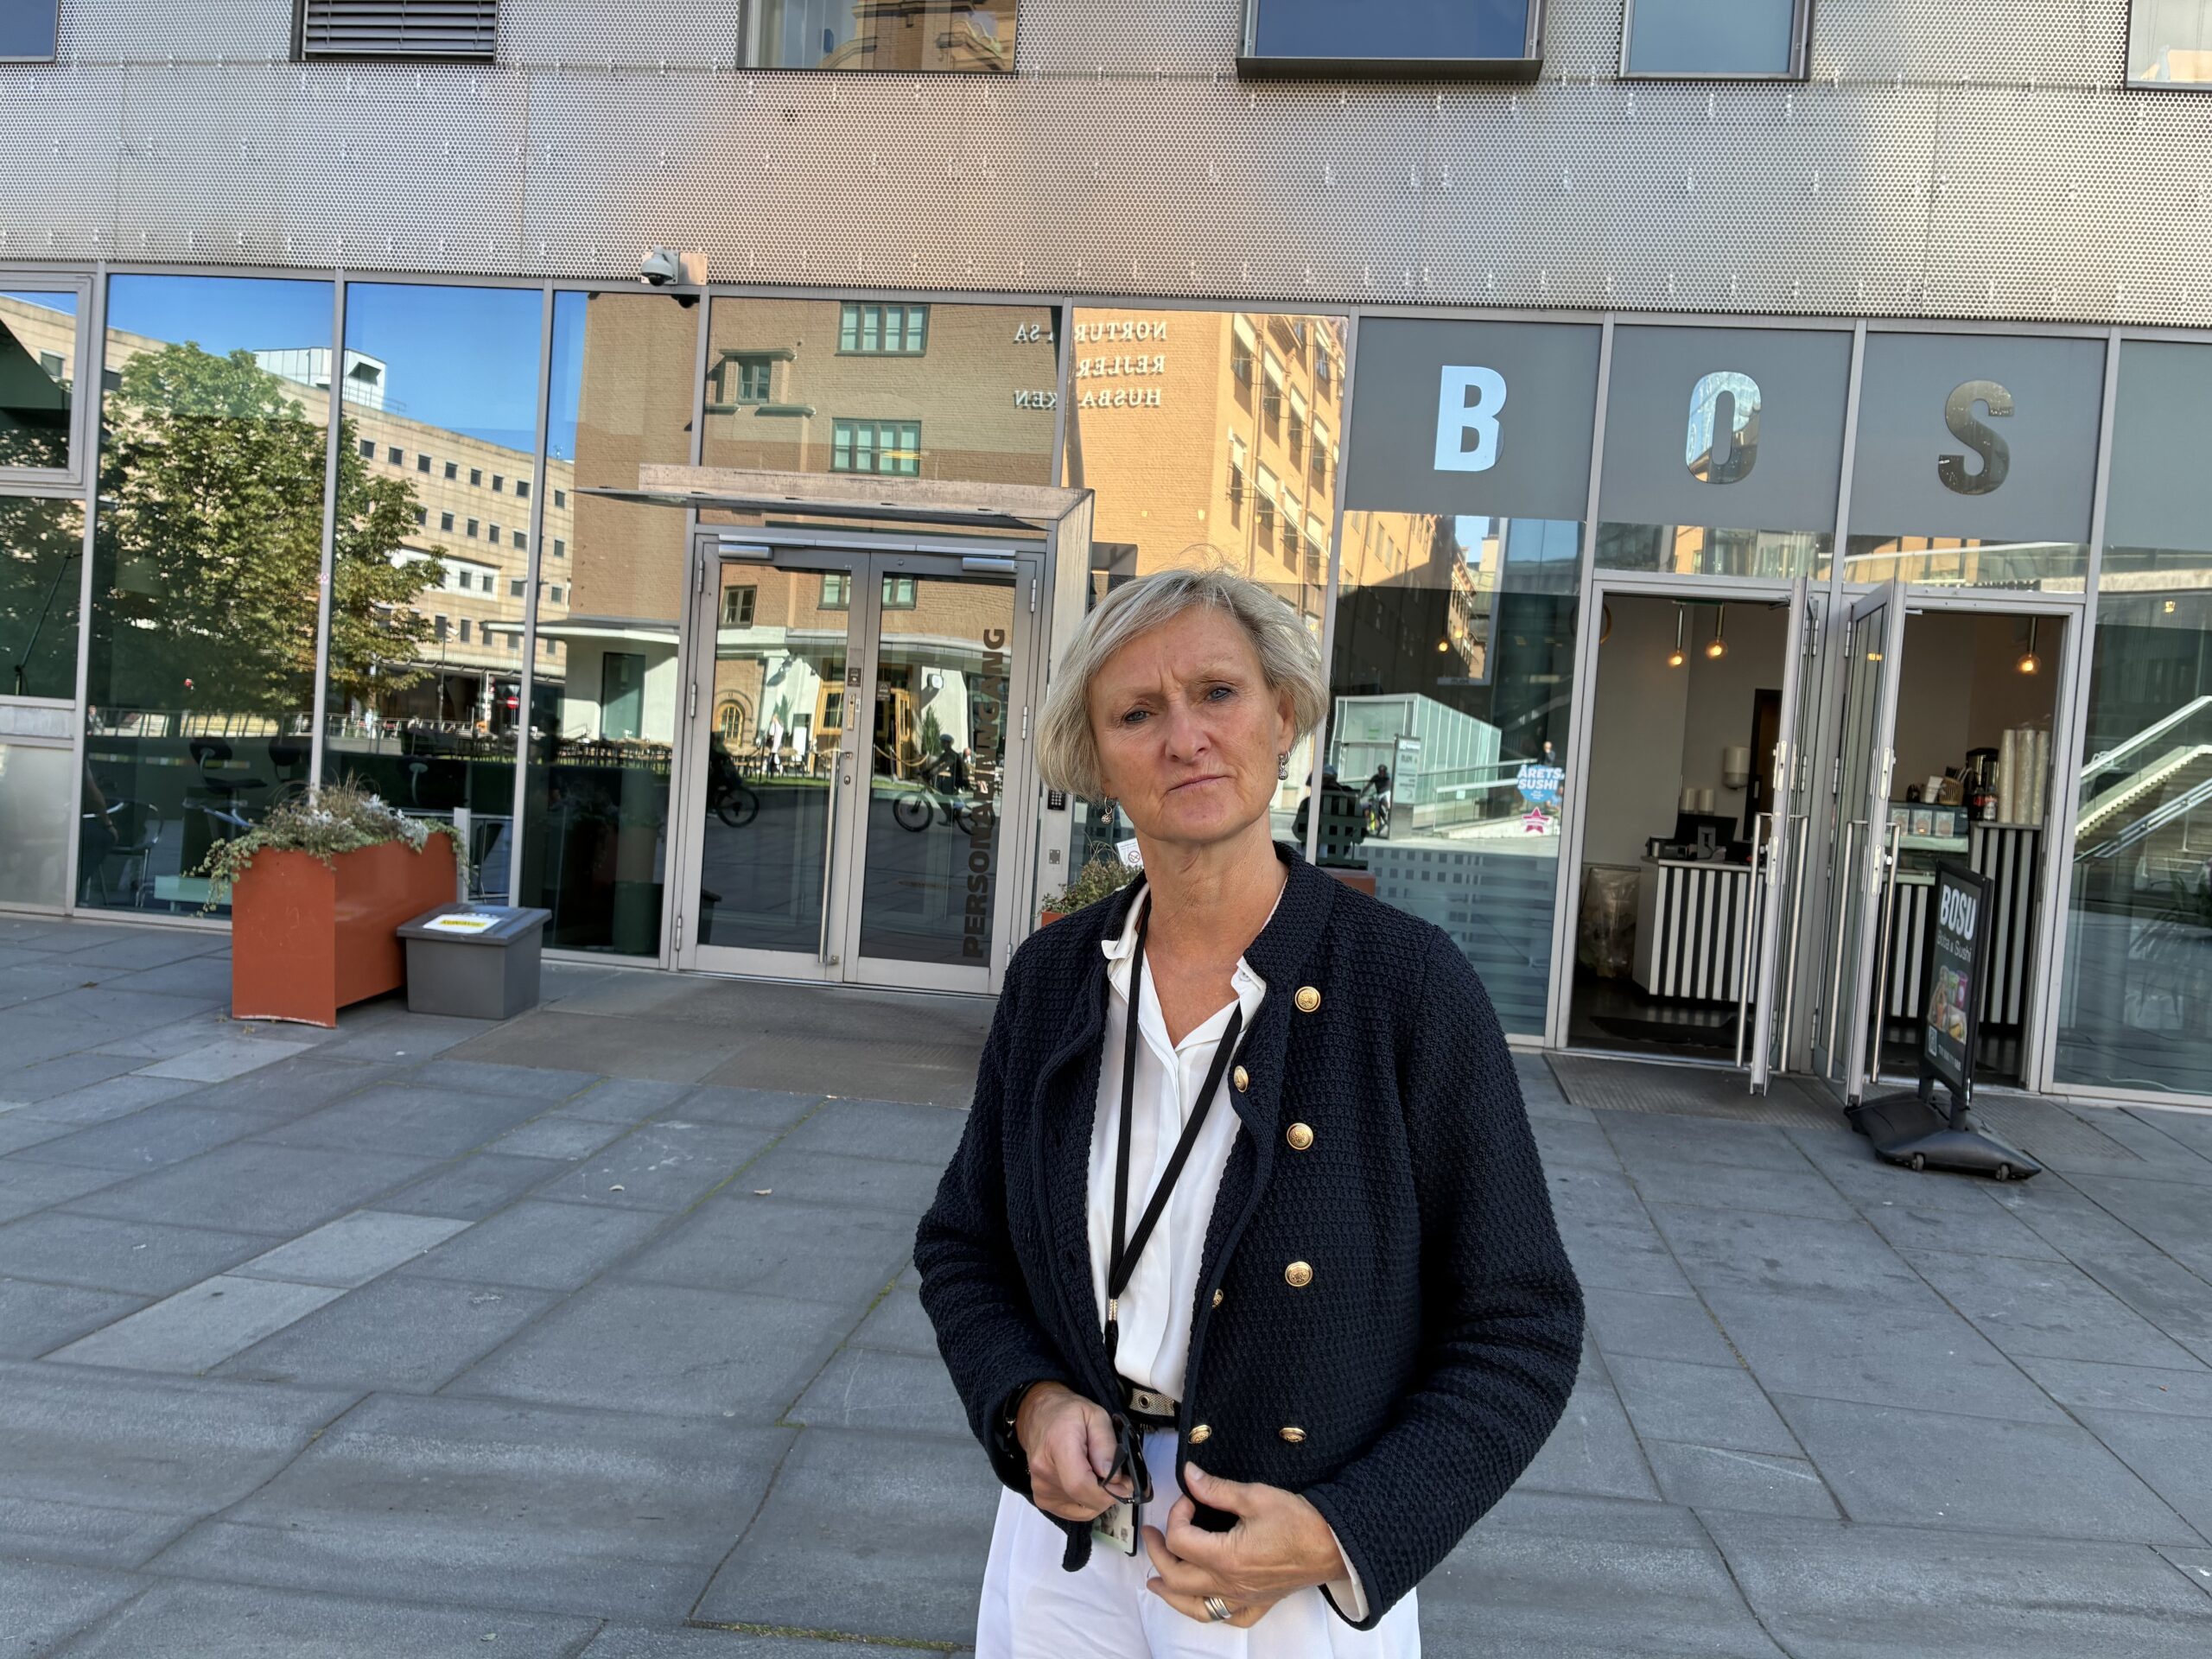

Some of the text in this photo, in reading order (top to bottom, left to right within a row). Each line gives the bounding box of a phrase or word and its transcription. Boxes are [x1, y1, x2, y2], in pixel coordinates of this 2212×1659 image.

[1517, 778, 1559, 790] SUSHI
[1940, 884, 1977, 941] BOSU
[1955, 940, 1973, 963] Sushi
